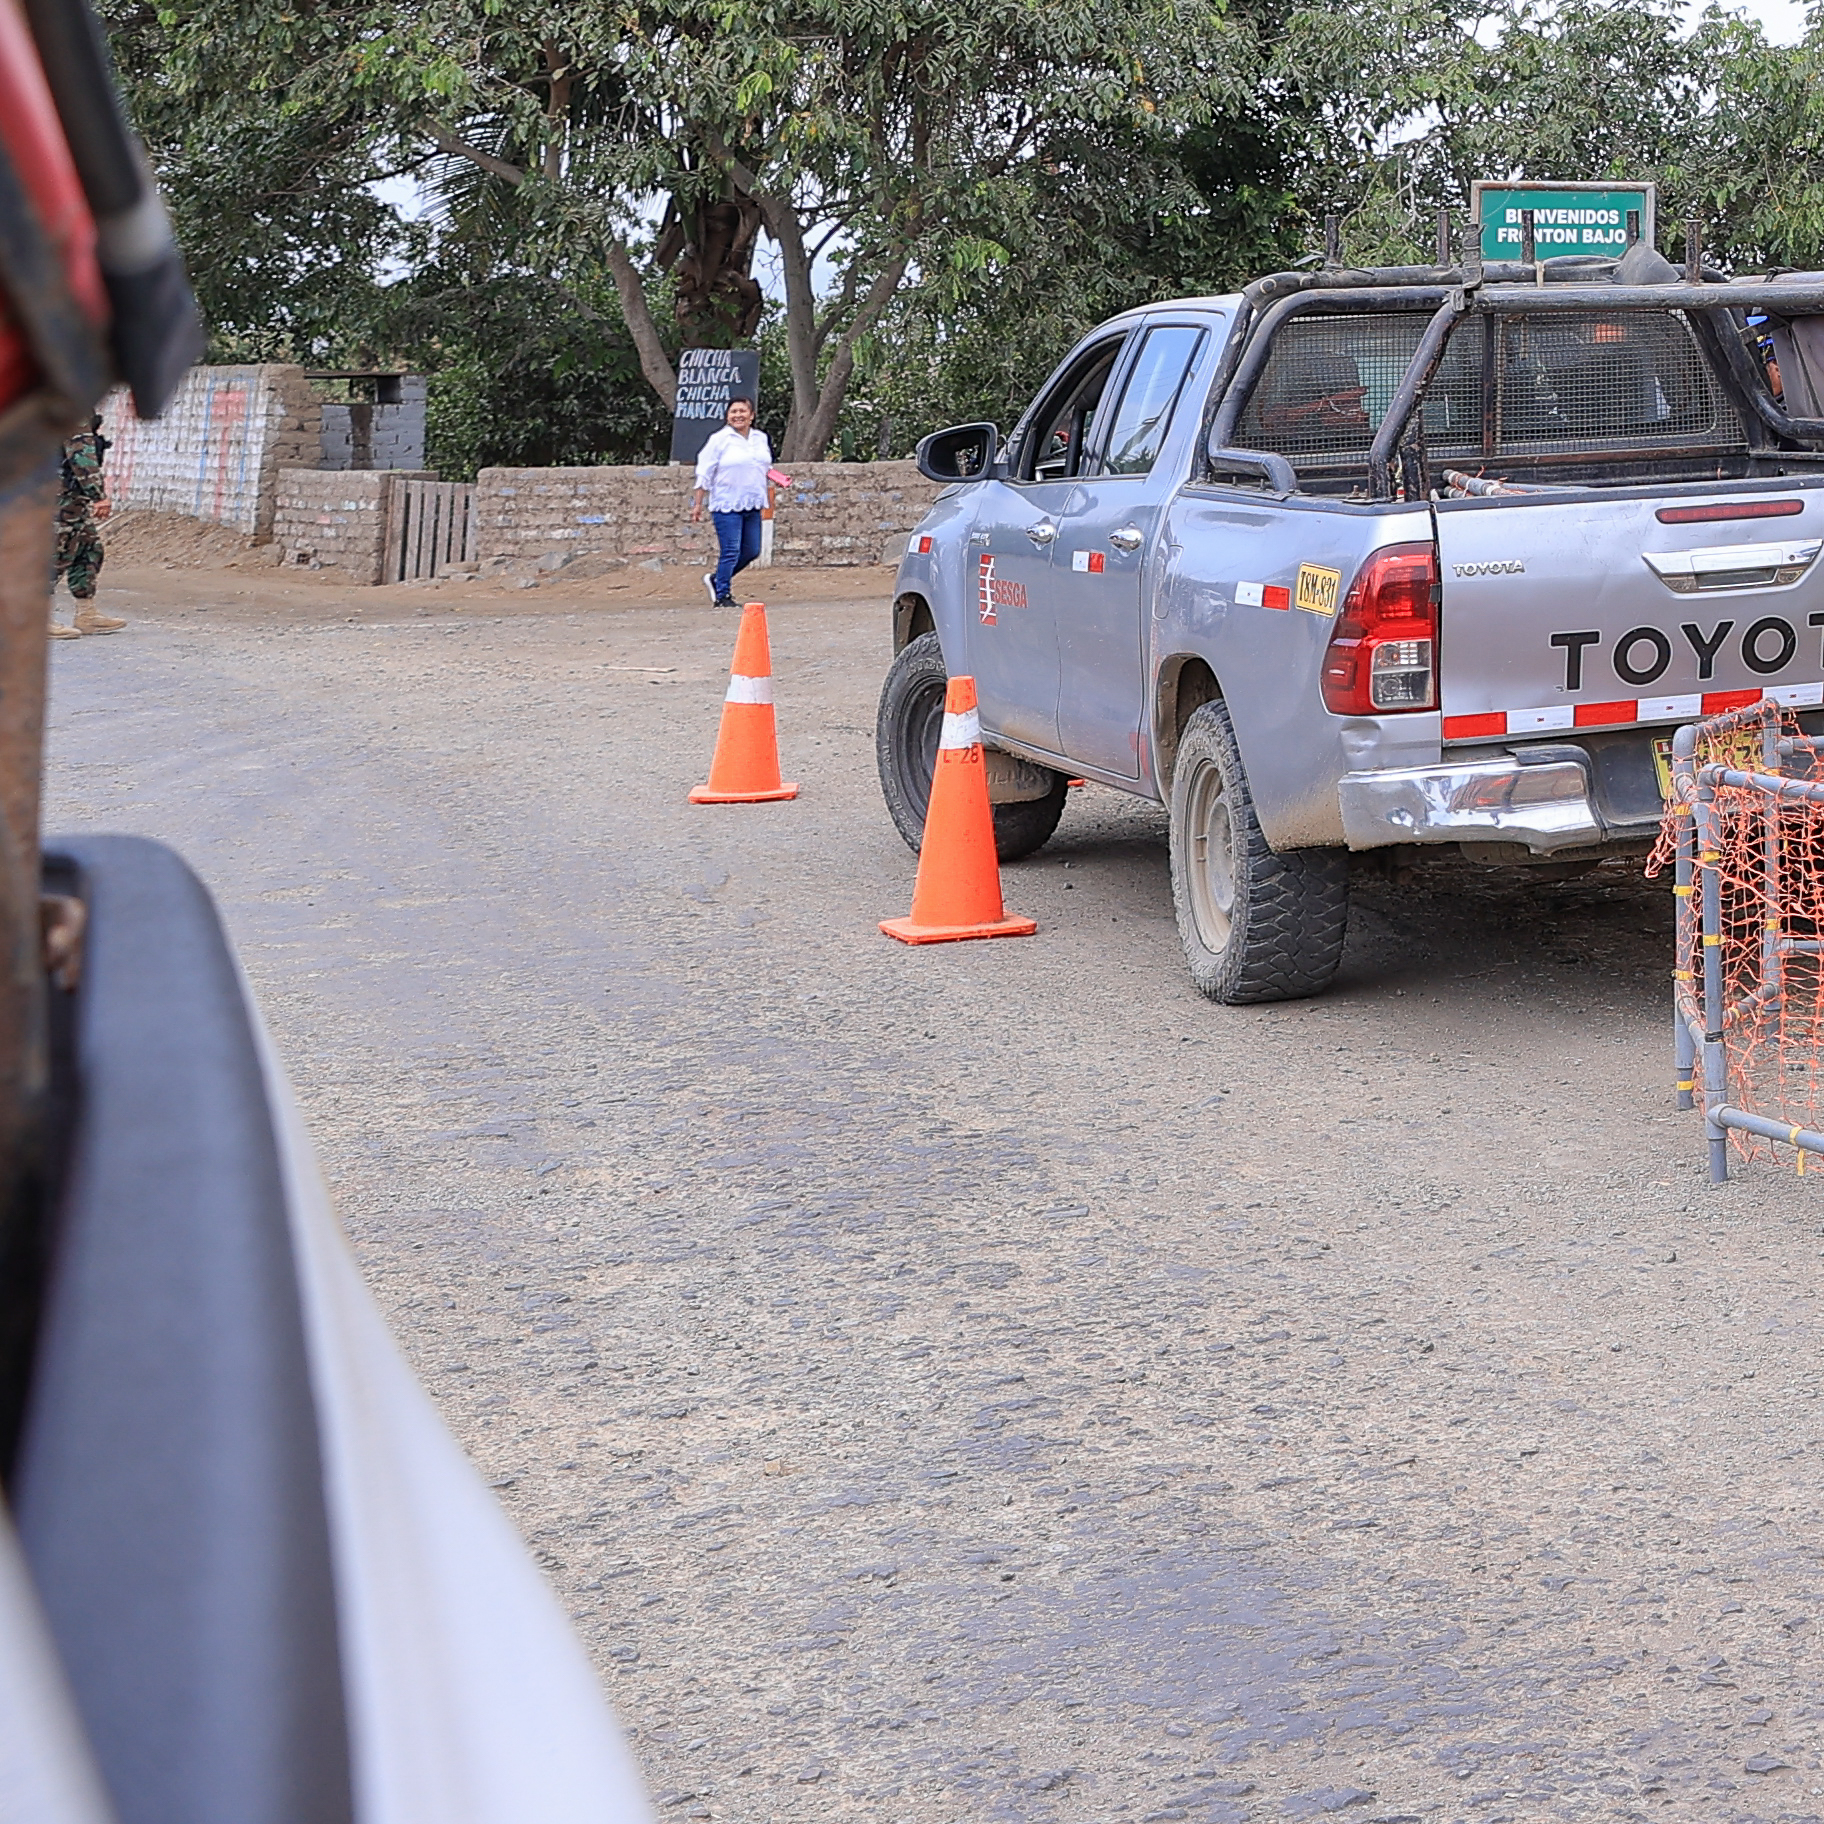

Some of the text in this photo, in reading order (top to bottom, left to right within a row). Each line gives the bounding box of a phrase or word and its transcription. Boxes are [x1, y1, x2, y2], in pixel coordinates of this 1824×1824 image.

[1505, 208, 1620, 225] BINVENIDOS
[1582, 228, 1627, 243] BAJO
[679, 349, 732, 368] CHICHA
[677, 367, 742, 385] BLANCA
[676, 385, 731, 401] CHICHA
[675, 402, 729, 420] MANZA
[1452, 559, 1525, 577] TOYOTA
[995, 579, 1028, 609] SESGA
[1299, 570, 1337, 609] T8M-831
[943, 745, 979, 764] L-28
